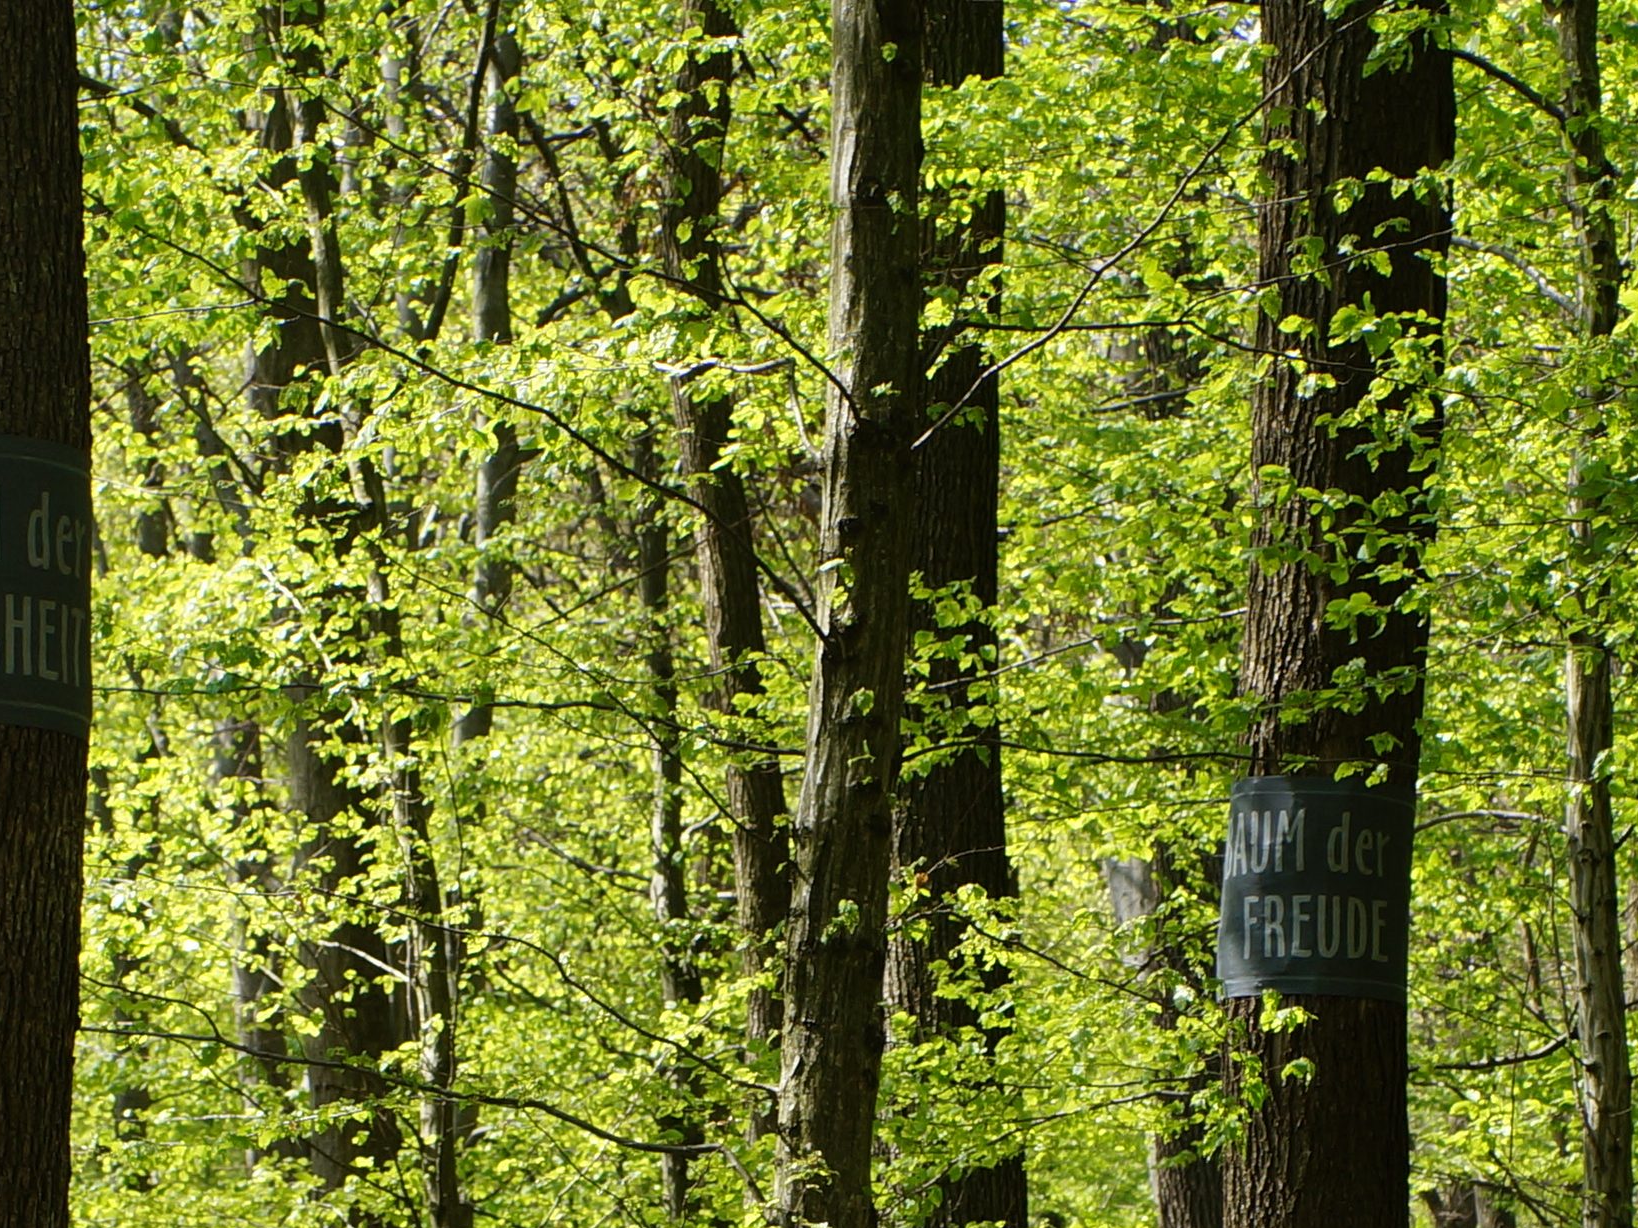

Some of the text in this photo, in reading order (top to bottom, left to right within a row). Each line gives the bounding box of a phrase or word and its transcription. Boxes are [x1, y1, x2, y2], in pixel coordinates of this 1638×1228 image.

[27, 491, 86, 579] der
[1327, 811, 1390, 877] der
[1243, 894, 1388, 962] FREUDE
